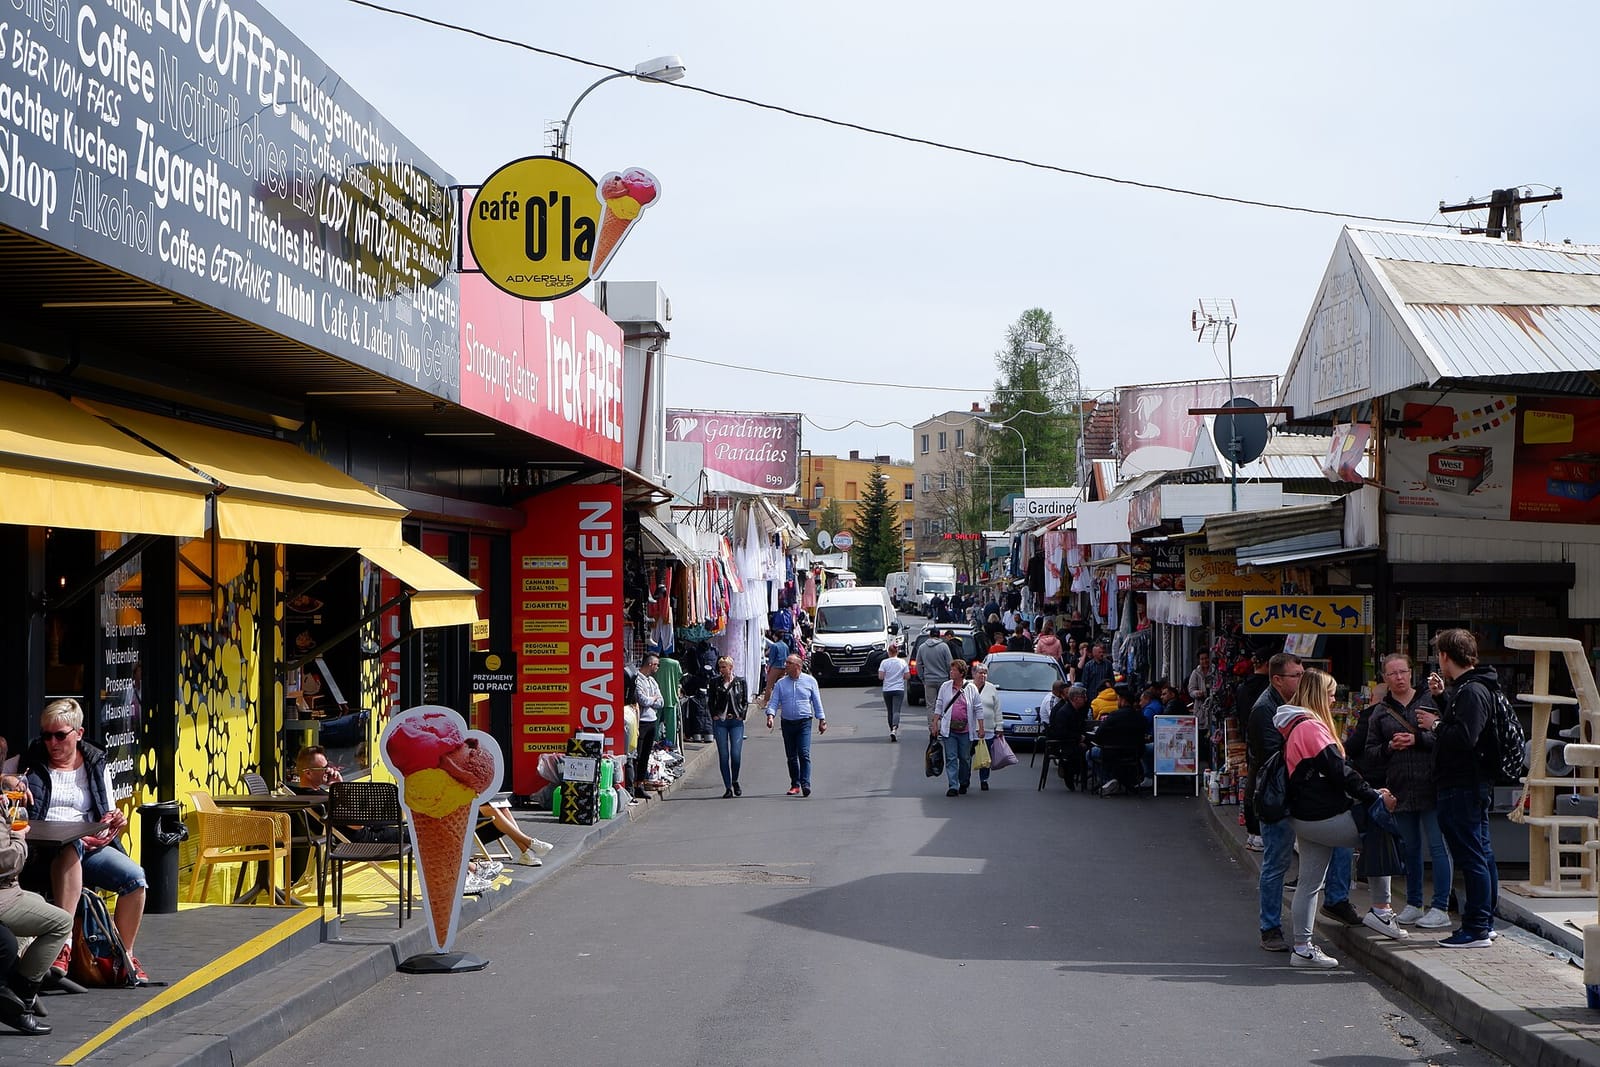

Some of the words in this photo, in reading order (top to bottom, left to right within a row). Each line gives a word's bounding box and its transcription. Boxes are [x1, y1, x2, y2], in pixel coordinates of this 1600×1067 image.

[77, 4, 155, 104] Coffee
[87, 78, 122, 127] FASS
[291, 54, 389, 178] Hausgemachter
[391, 143, 429, 210] Kuchen
[159, 46, 288, 200] Natürliches
[293, 143, 316, 217] Eis
[319, 177, 353, 237] LODY
[354, 202, 412, 275] NATURALNE
[311, 134, 342, 181] Coffee
[63, 108, 129, 181] Kuchen
[135, 117, 242, 233] Zigaretten
[248, 195, 299, 266] Frisches
[303, 229, 325, 280] Bier
[327, 251, 353, 294] vom
[356, 259, 377, 306] Fass
[479, 191, 520, 221] café
[69, 168, 155, 256] Alkohol
[158, 220, 206, 277] Coffee
[210, 243, 273, 304] GETRÄNKE
[276, 272, 315, 328] Alkohol
[321, 292, 349, 341] Cafe
[351, 305, 361, 346] &
[363, 310, 394, 361] Laden
[400, 330, 421, 383] Shop
[506, 274, 574, 283] ADVERSUS
[465, 322, 511, 402] Shopping
[512, 351, 539, 405] Center
[540, 301, 584, 427] Trek
[586, 329, 622, 443] FREE
[704, 418, 783, 443] Gardinen
[714, 442, 788, 463] Paradies
[1439, 459, 1462, 470] West
[765, 475, 783, 485] B99
[1435, 475, 1455, 486] West
[1249, 603, 1327, 629] CAMEL
[105, 647, 139, 664] Weizenbier
[473, 683, 485, 691] DO
[486, 683, 513, 691] PRACY
[105, 728, 135, 748] Souvenirs
